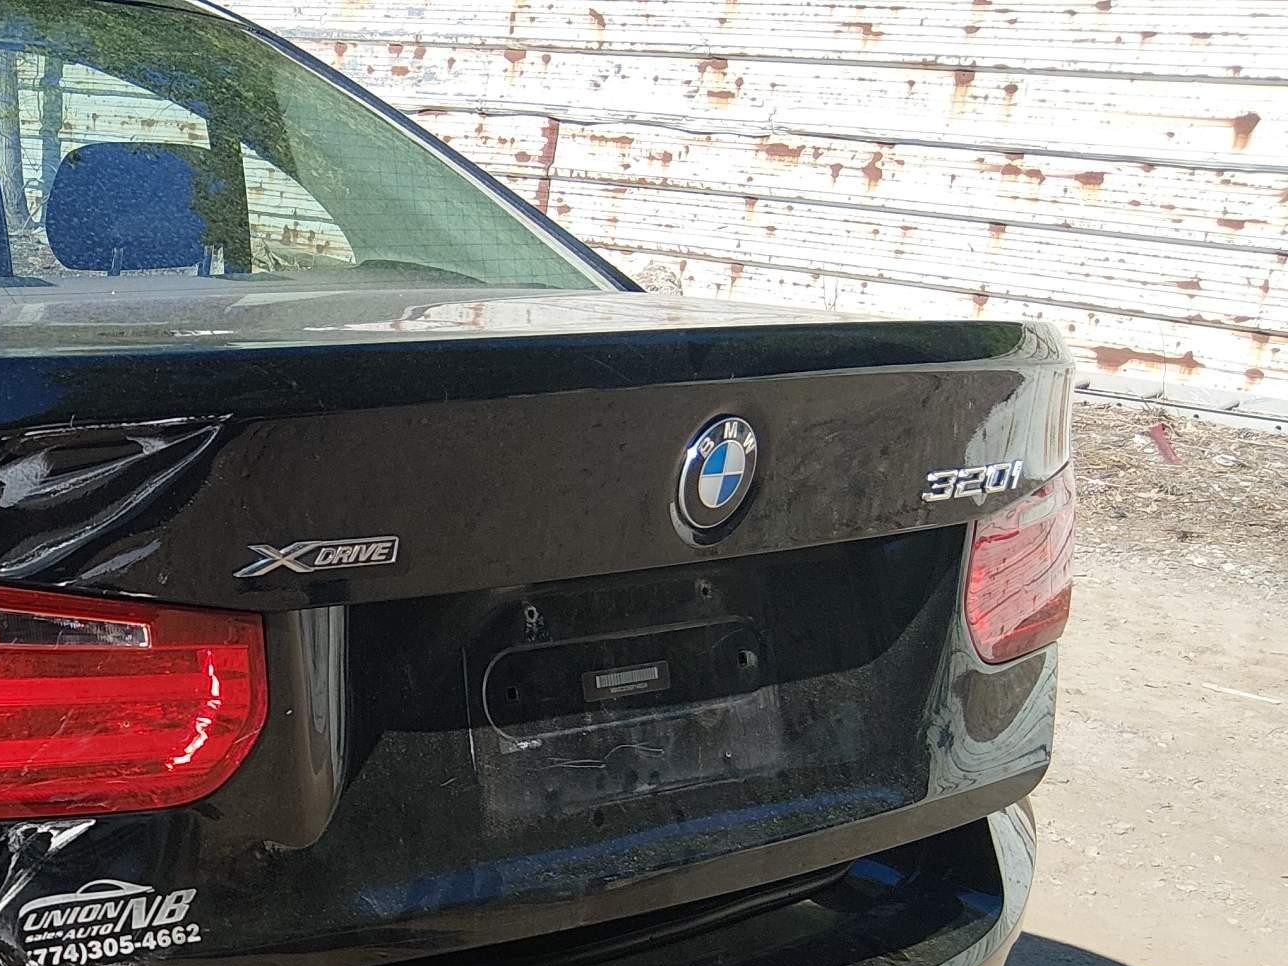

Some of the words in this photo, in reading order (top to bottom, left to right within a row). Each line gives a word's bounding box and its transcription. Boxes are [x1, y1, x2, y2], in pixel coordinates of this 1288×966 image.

[699, 421, 756, 457] BMW
[23, 900, 124, 931] UNION
[114, 888, 197, 933] NB
[62, 923, 114, 941] AUTO
